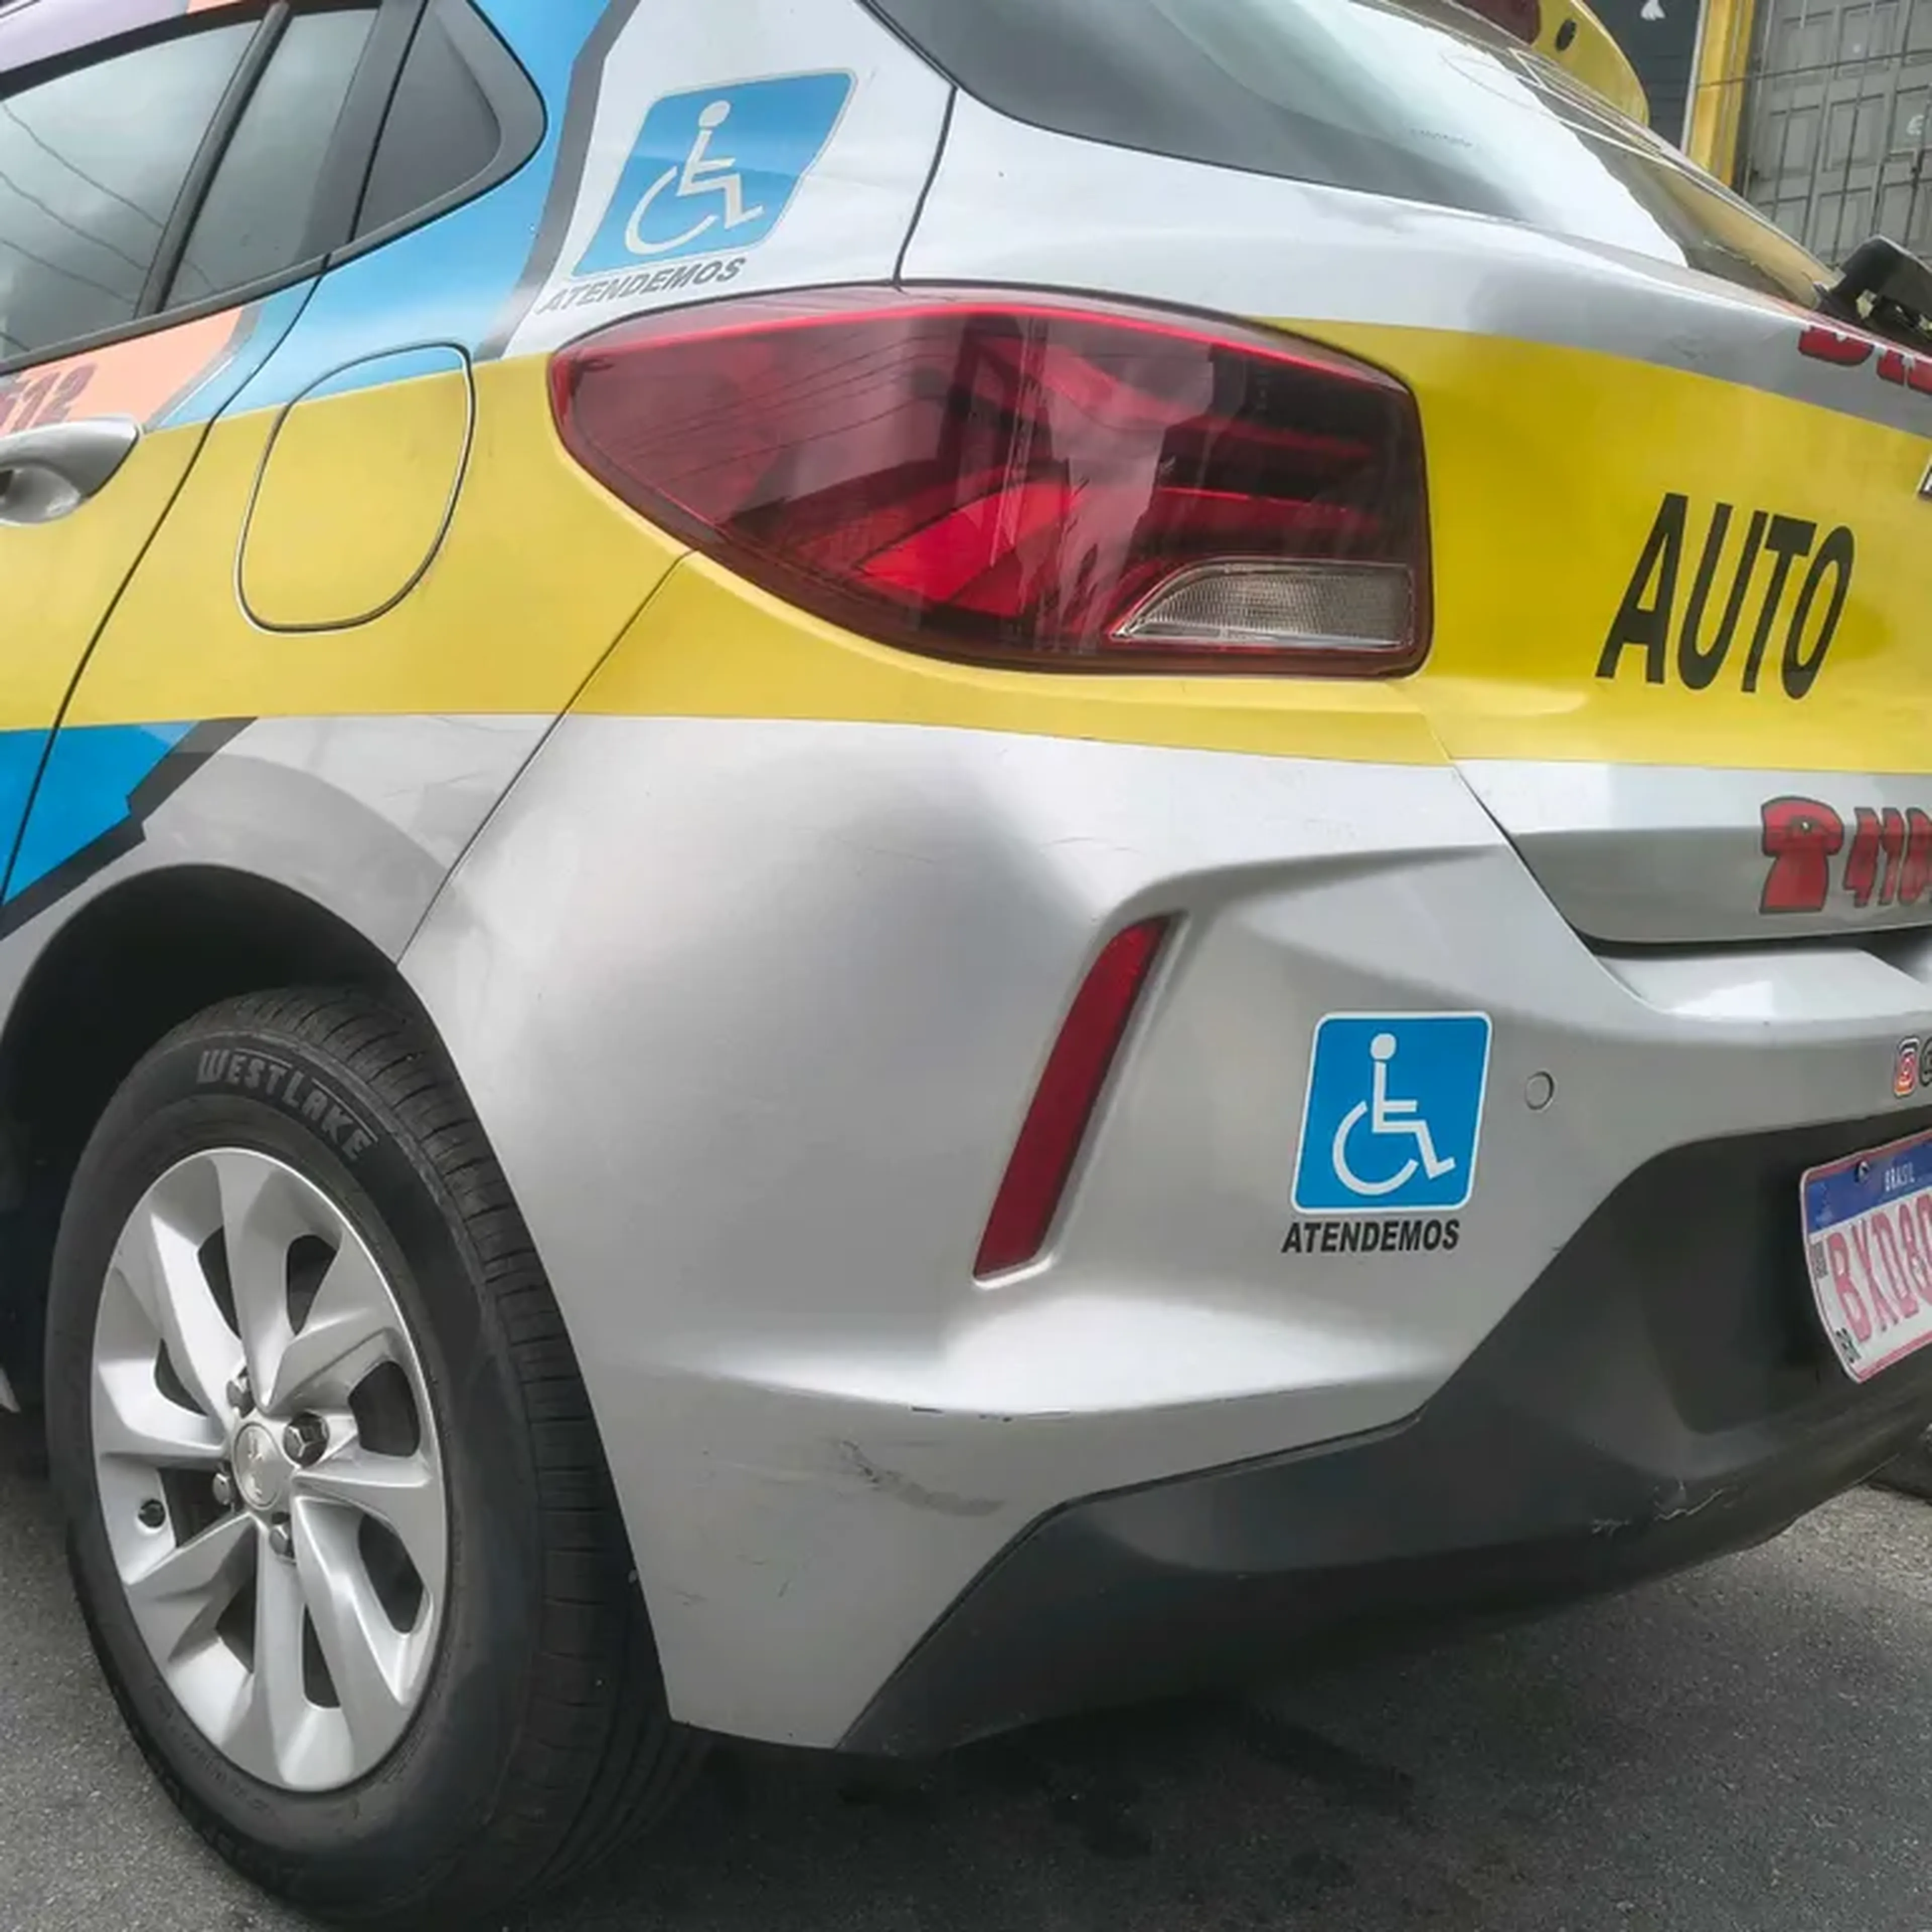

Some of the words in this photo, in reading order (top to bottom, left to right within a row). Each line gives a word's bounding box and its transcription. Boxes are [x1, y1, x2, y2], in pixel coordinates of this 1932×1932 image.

[535, 257, 746, 315] ATENDEMOS
[1595, 492, 1855, 699] AUTO
[197, 1049, 372, 1159] WESTLAKE
[1281, 1219, 1460, 1253] ATENDEMOS
